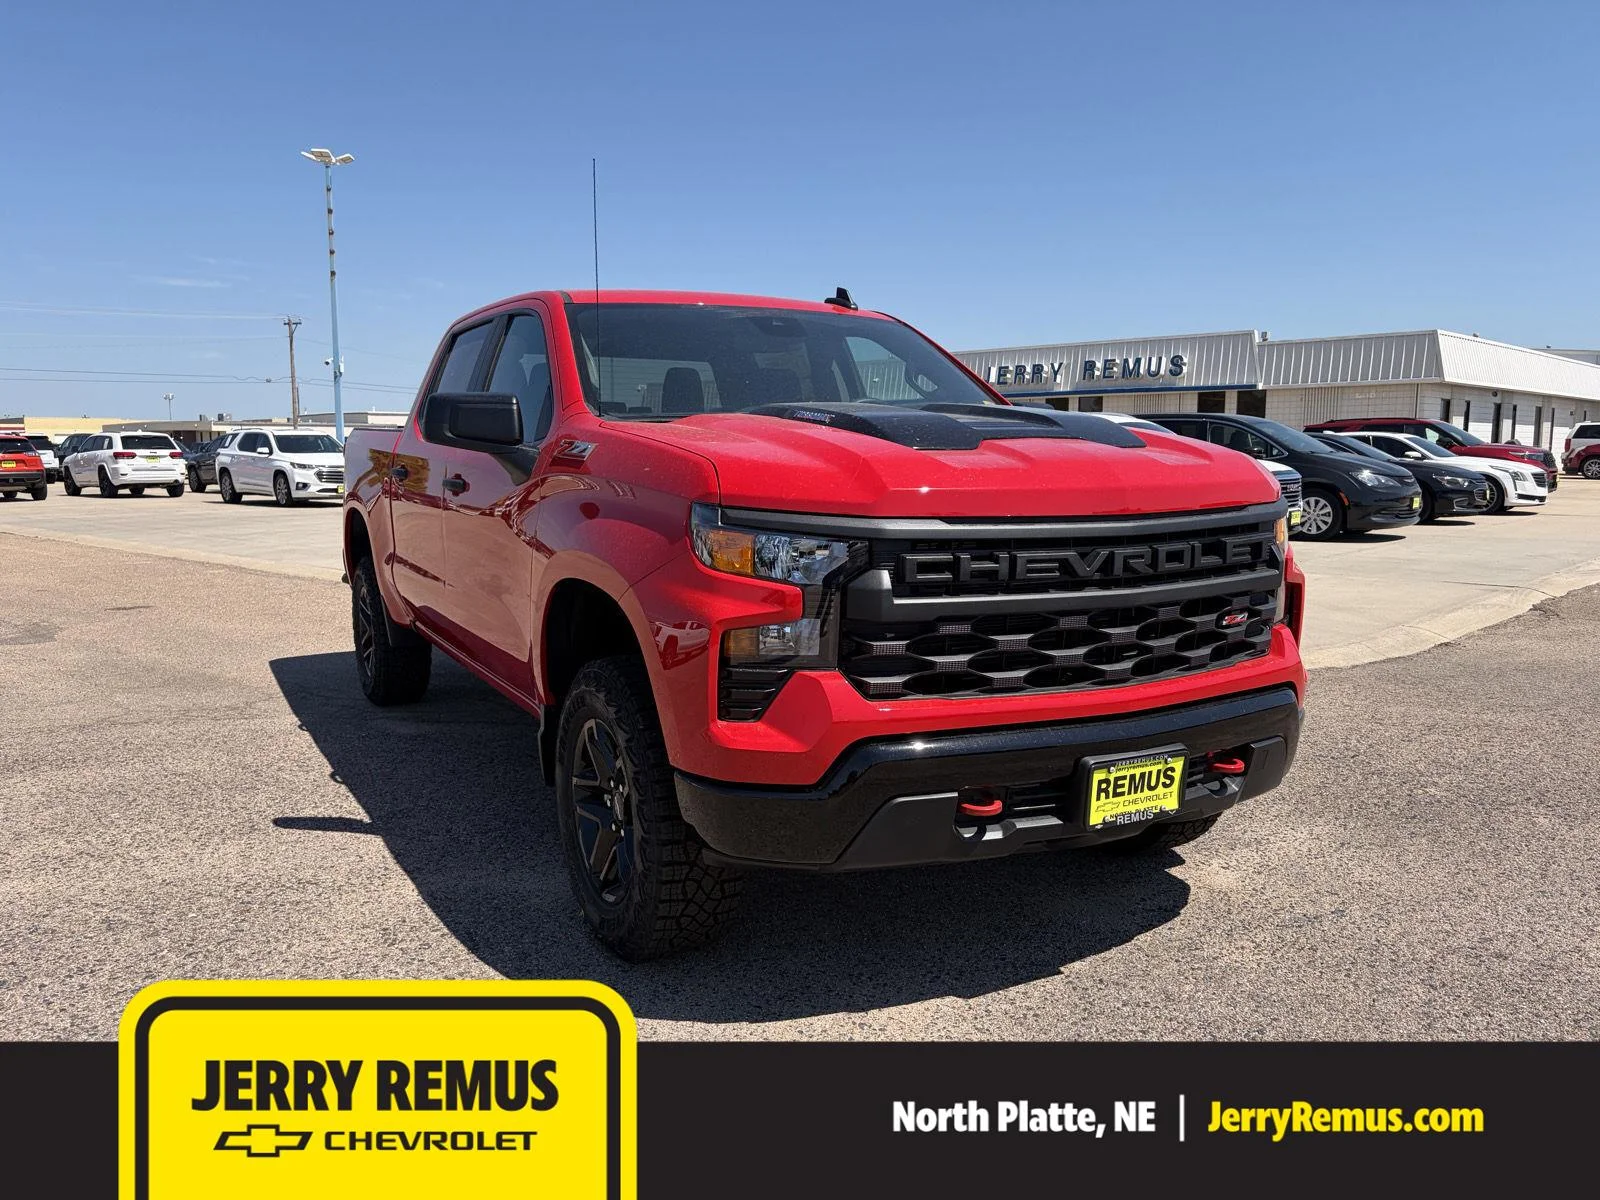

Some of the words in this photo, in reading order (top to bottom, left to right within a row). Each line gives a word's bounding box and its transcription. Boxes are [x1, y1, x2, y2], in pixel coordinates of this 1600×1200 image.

[1082, 354, 1187, 381] REMUS
[901, 532, 1274, 583] CHEVROLET
[1096, 767, 1176, 802] REMUS
[1122, 791, 1174, 807] CHEVROLET
[1117, 810, 1154, 826] REMUS
